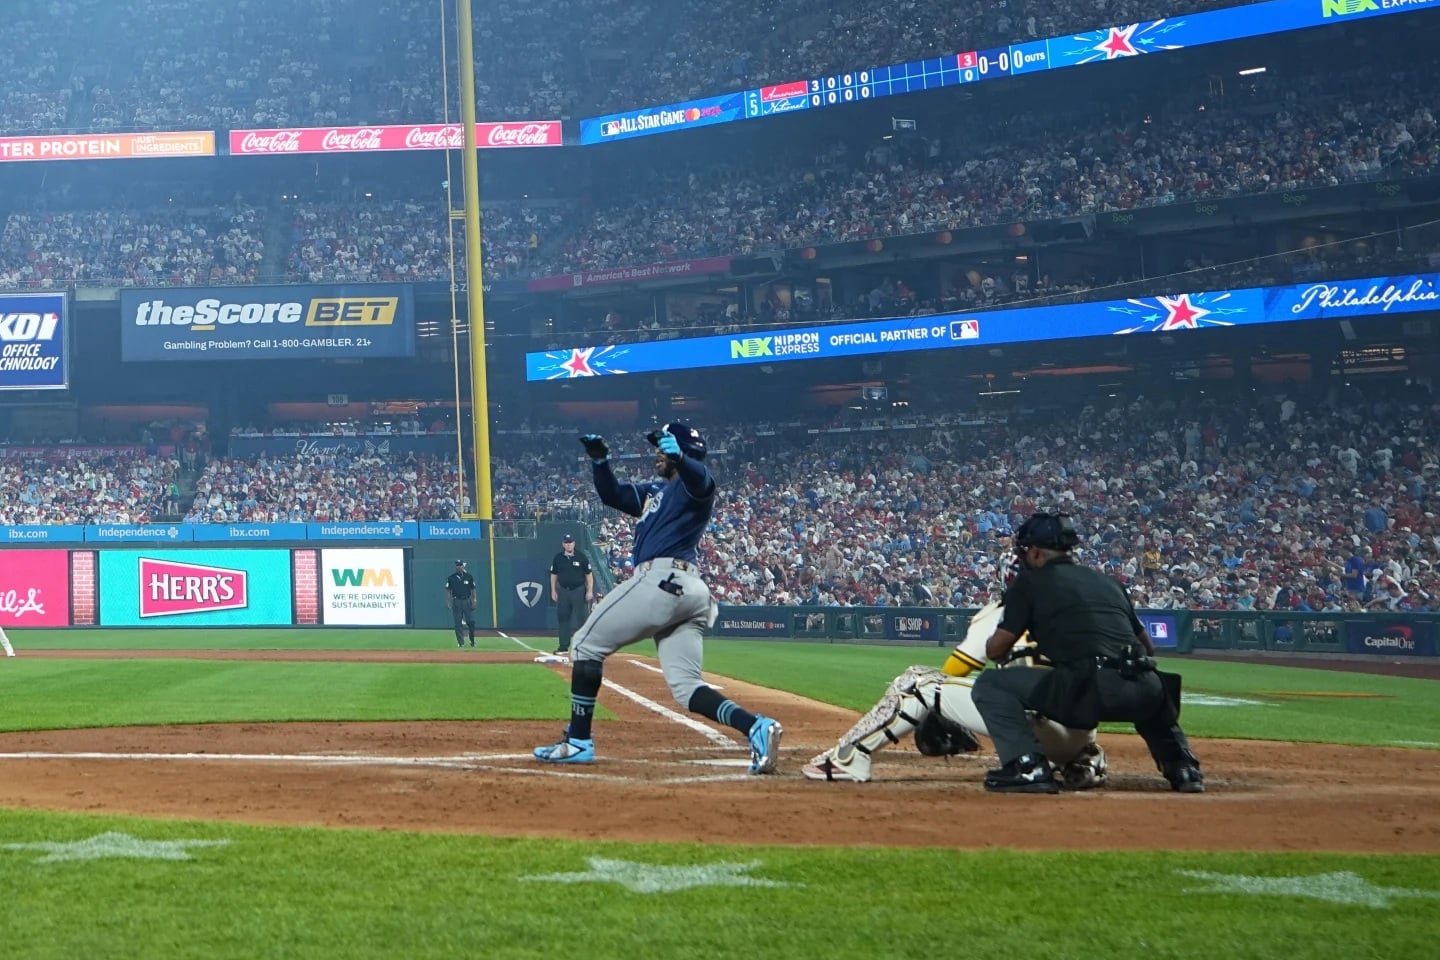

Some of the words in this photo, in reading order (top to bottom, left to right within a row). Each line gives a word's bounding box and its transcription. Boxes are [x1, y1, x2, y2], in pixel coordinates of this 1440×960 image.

[1013, 50, 1023, 68] 0
[1025, 52, 1046, 62] OUTS
[811, 81, 819, 92] 3
[828, 77, 836, 88] 0
[844, 75, 852, 86] 0
[860, 72, 869, 83] 0
[964, 55, 972, 66] 3
[750, 99, 758, 116] 5
[812, 95, 820, 106] 0
[829, 92, 836, 103] 0
[845, 90, 853, 101] 0
[861, 87, 869, 98] 0
[965, 70, 973, 81] 0
[661, 110, 686, 126] GAME
[241, 131, 302, 152] Coca-Cola
[322, 129, 383, 150] Coca-Cola
[488, 124, 552, 145] Coca-Cola
[40, 139, 121, 155] PROTEIN
[136, 142, 200, 152] INGREDIENTS
[587, 269, 630, 283] America's
[631, 266, 654, 278] Best
[655, 263, 691, 275] Network
[1292, 279, 1440, 313] Philadelphia
[136, 298, 303, 326] theScore
[314, 301, 390, 322] BET
[774, 332, 819, 346] NIPPON
[830, 331, 878, 346] OFFICIAL
[880, 328, 929, 343] PARTNER
[931, 326, 946, 340] OF
[2, 344, 41, 357] OFFICE
[163, 341, 207, 351] Gambling
[208, 339, 251, 349] Problem?
[253, 339, 271, 348] Call
[356, 338, 372, 347] 21+
[775, 343, 820, 355] EXPRESS
[8, 528, 48, 539] ibx.com
[98, 527, 166, 538] Independence
[229, 527, 270, 537] ibx.com
[321, 525, 390, 537] Independence
[429, 525, 471, 535] ibx.com
[331, 568, 396, 587] WM
[149, 574, 234, 602] HERR'S
[333, 593, 359, 601] WE'RE
[907, 617, 922, 630] SHOP
